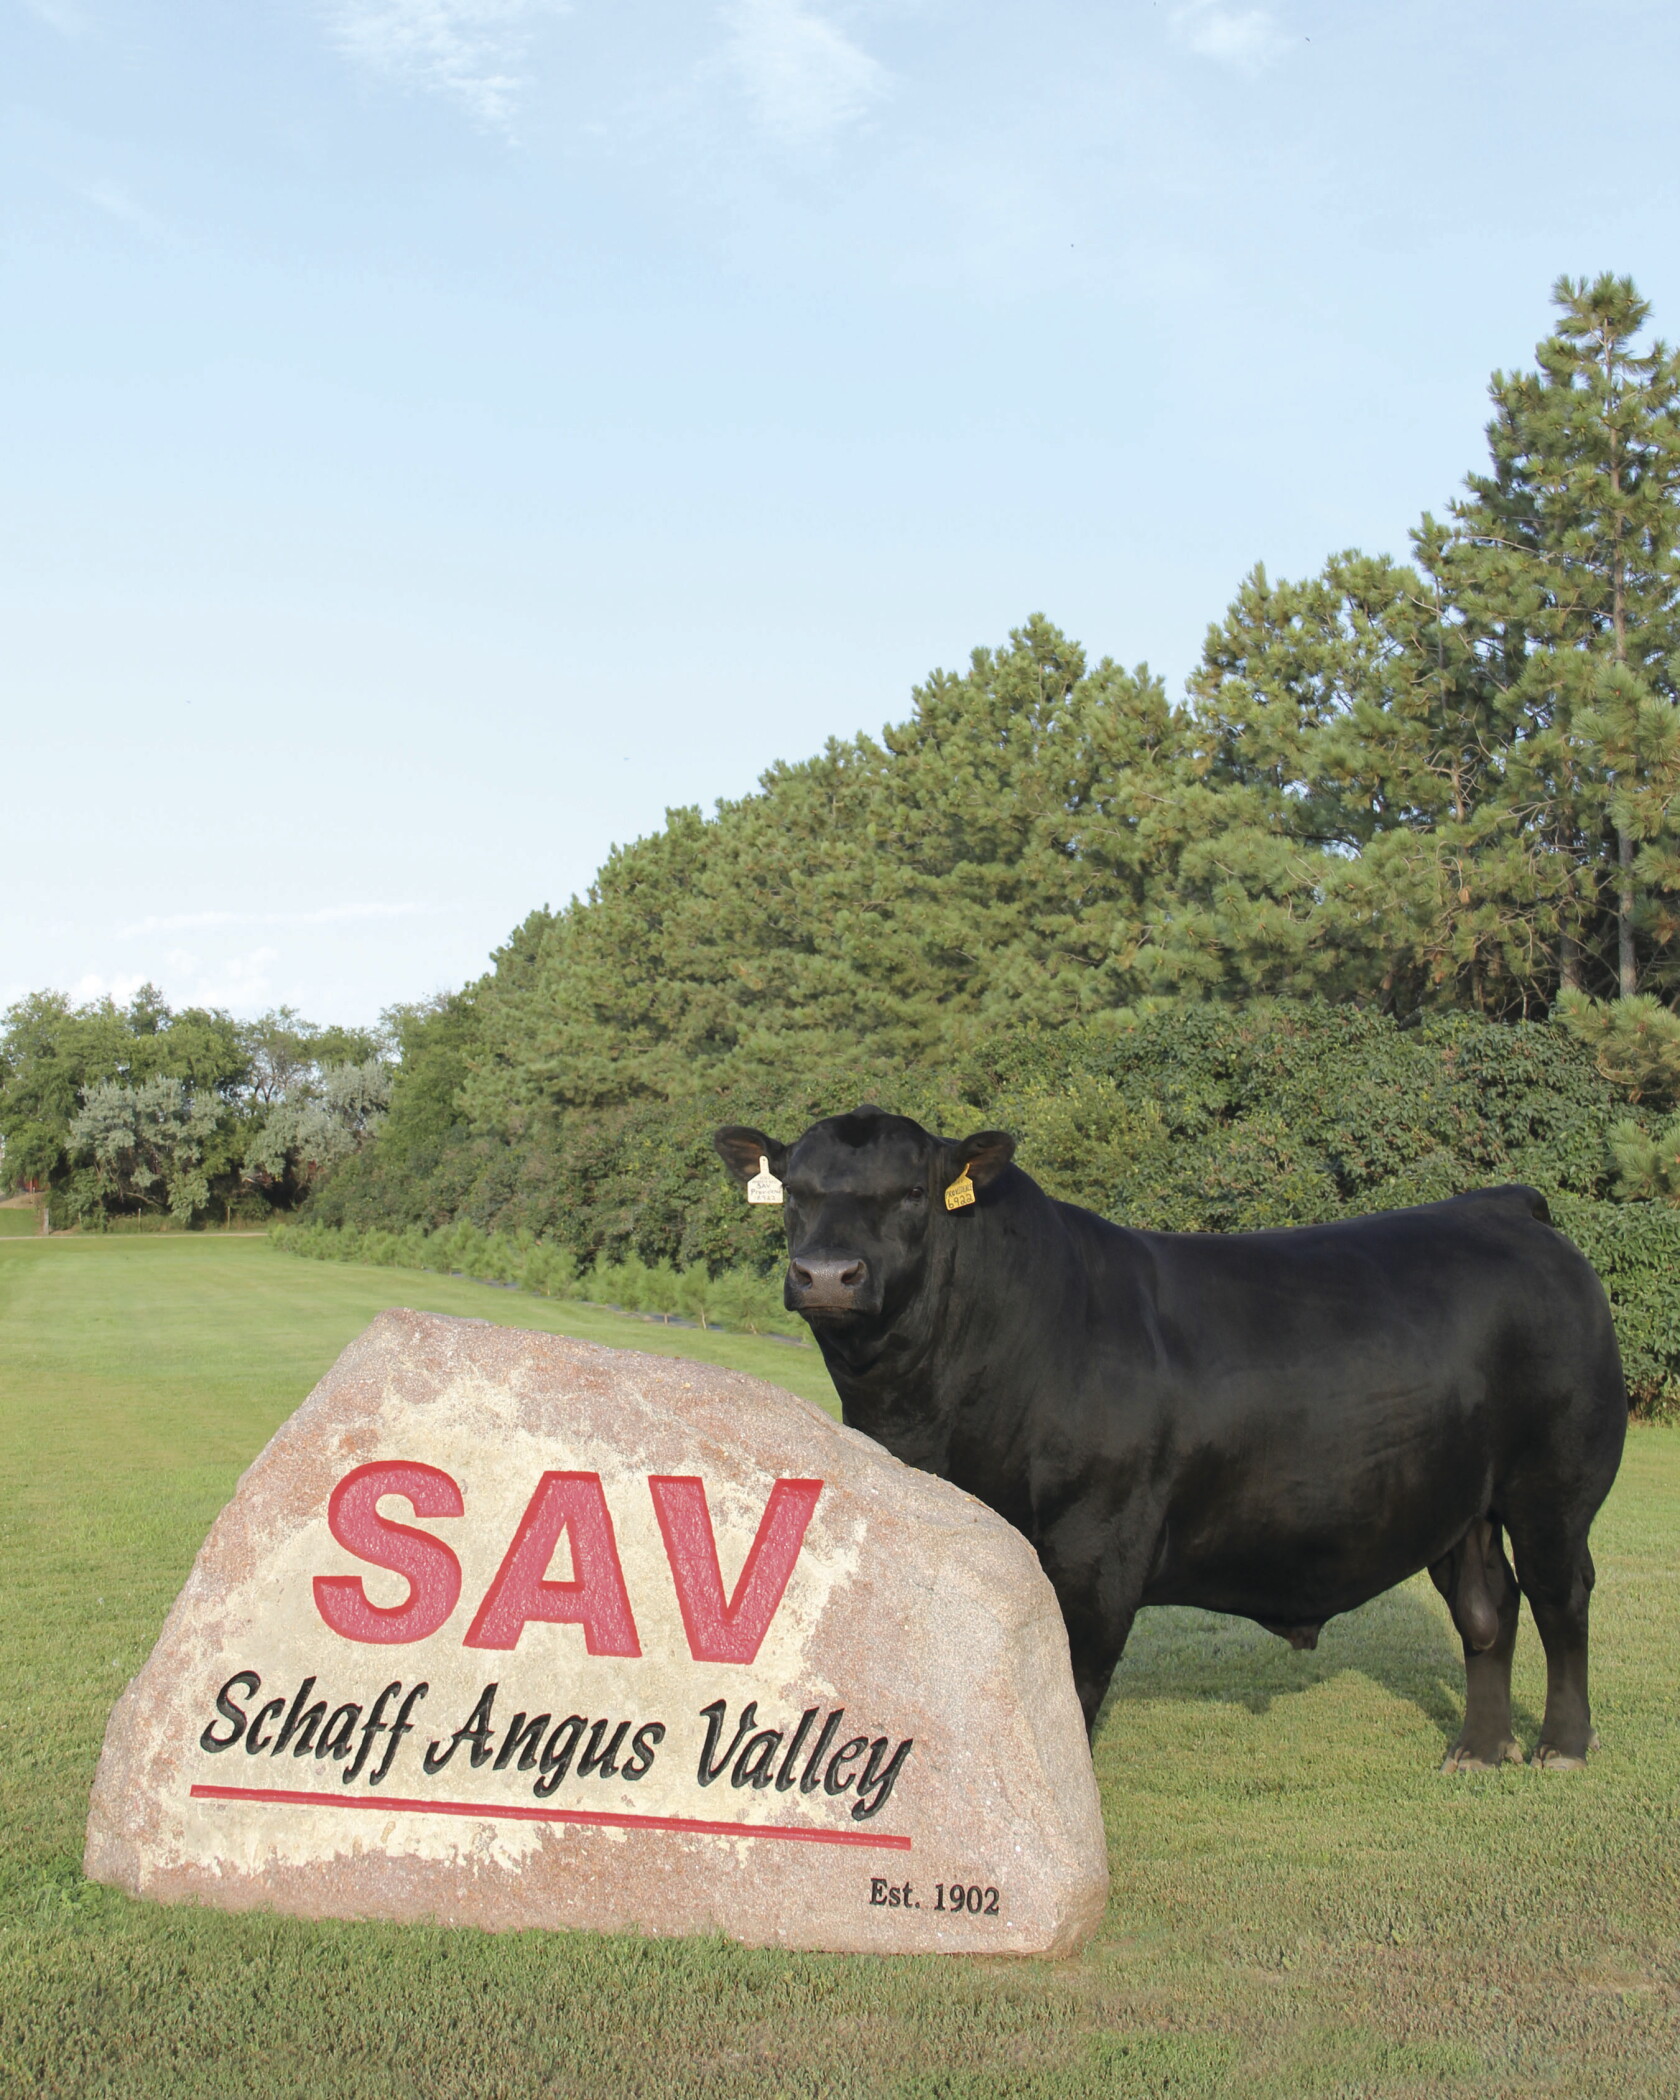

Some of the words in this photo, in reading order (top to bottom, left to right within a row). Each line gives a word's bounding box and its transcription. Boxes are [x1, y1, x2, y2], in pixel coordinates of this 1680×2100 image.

[947, 1193, 974, 1208] 6922
[312, 1459, 825, 1665] SAV
[200, 1669, 429, 1786] Schaff
[423, 1682, 666, 1798] Angus
[697, 1698, 914, 1821] Valley
[869, 1877, 921, 1908] Est.
[934, 1883, 1000, 1916] 1902
